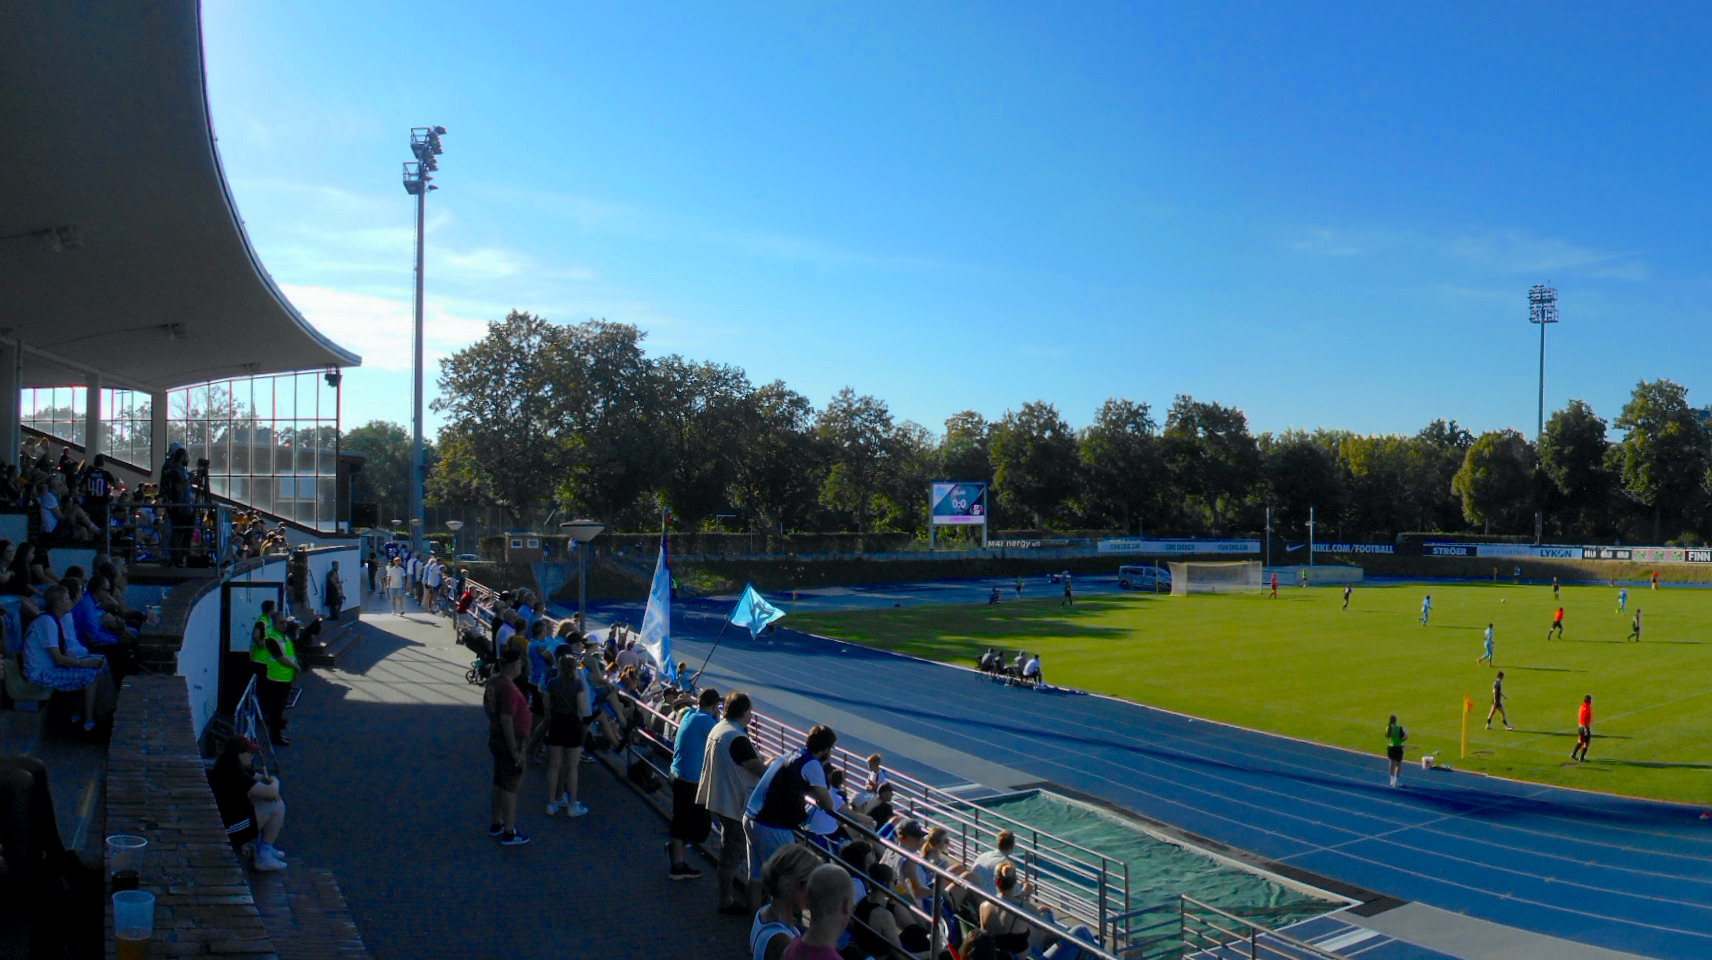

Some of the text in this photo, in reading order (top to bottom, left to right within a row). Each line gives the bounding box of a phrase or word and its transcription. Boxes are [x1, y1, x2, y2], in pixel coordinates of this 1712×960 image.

[1312, 543, 1394, 553] NIKE.COM/FOOTBALL
[1433, 546, 1467, 555] STRÖER
[1540, 549, 1572, 558] LYKON
[1688, 551, 1711, 561] FINN
